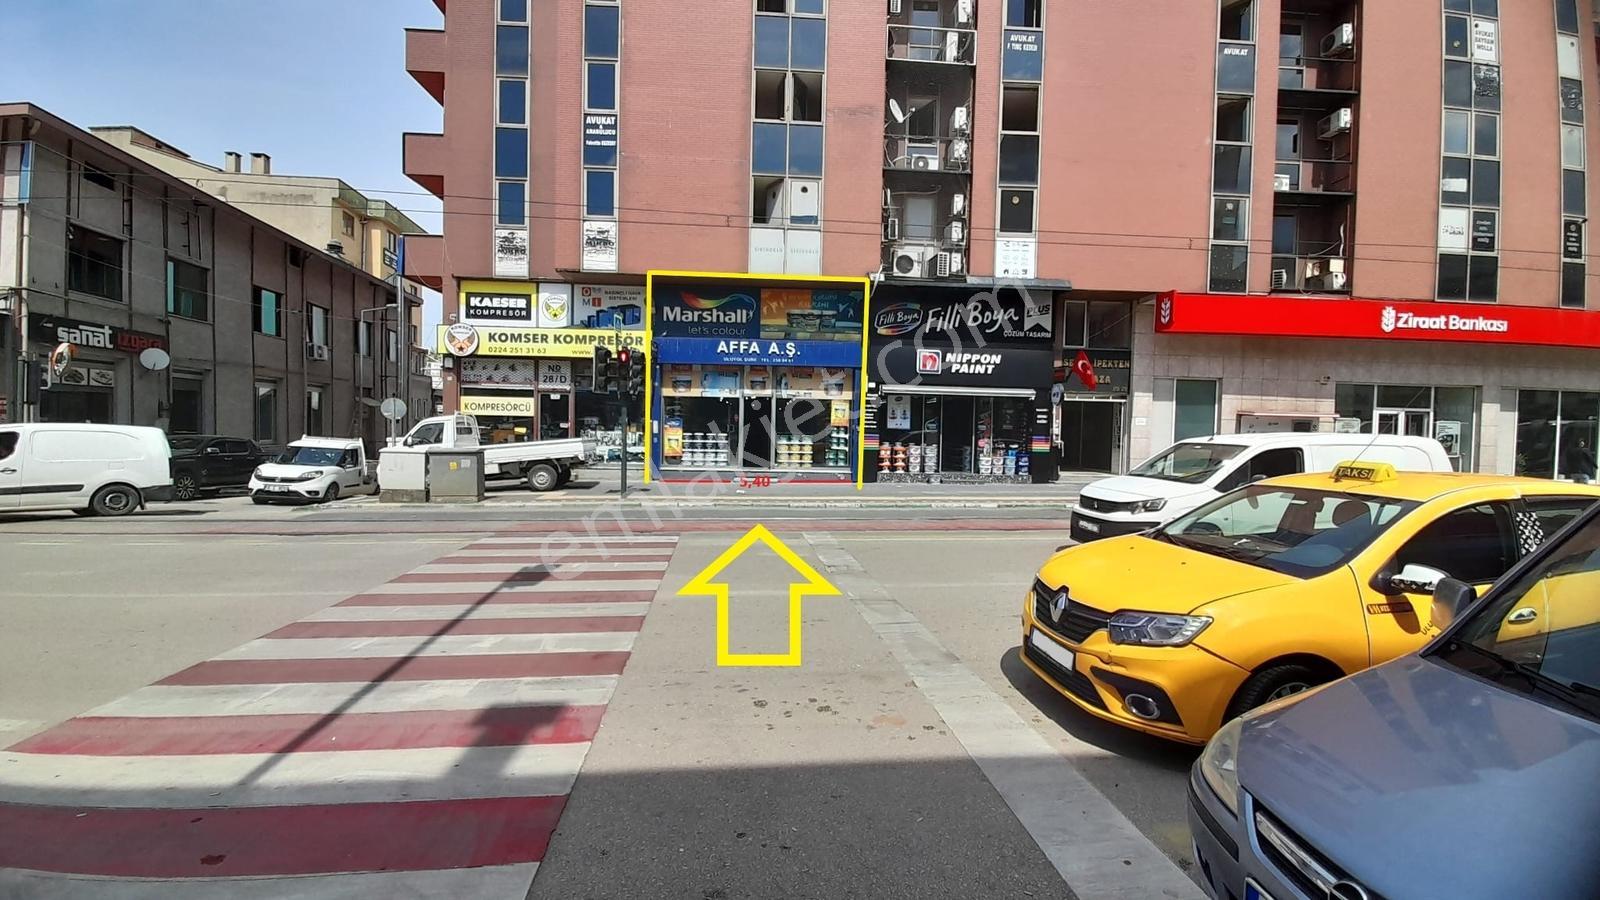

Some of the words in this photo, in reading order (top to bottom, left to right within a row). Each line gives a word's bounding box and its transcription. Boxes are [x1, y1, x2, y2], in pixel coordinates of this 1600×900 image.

[1010, 34, 1036, 42] AVUKAT
[1223, 48, 1248, 56] AVUKAT
[586, 116, 616, 125] AVUKAT
[469, 297, 527, 308] KAESER
[469, 308, 527, 317] KOMPRESÖR
[663, 306, 747, 323] Marshall
[1026, 304, 1051, 317] PLUS
[879, 311, 895, 326] Filli
[897, 311, 920, 325] Boya
[925, 302, 962, 333] Filli
[967, 301, 1019, 333] Boya
[1396, 312, 1447, 330] Ziraat
[1448, 314, 1508, 332] Bankası
[688, 325, 709, 335] let's
[711, 326, 746, 336] colour
[57, 325, 114, 349] sanat
[488, 332, 549, 344] KOMSER
[553, 332, 644, 347] KOMPRESÖR
[488, 346, 508, 354] 0224
[717, 340, 760, 354] AFFA
[768, 341, 801, 358] A.Ş.
[945, 352, 1002, 364] NIPPON
[951, 363, 996, 375] PAINT
[542, 375, 567, 384] 28/D
[463, 401, 531, 412] KOMPRESÖRCÜ
